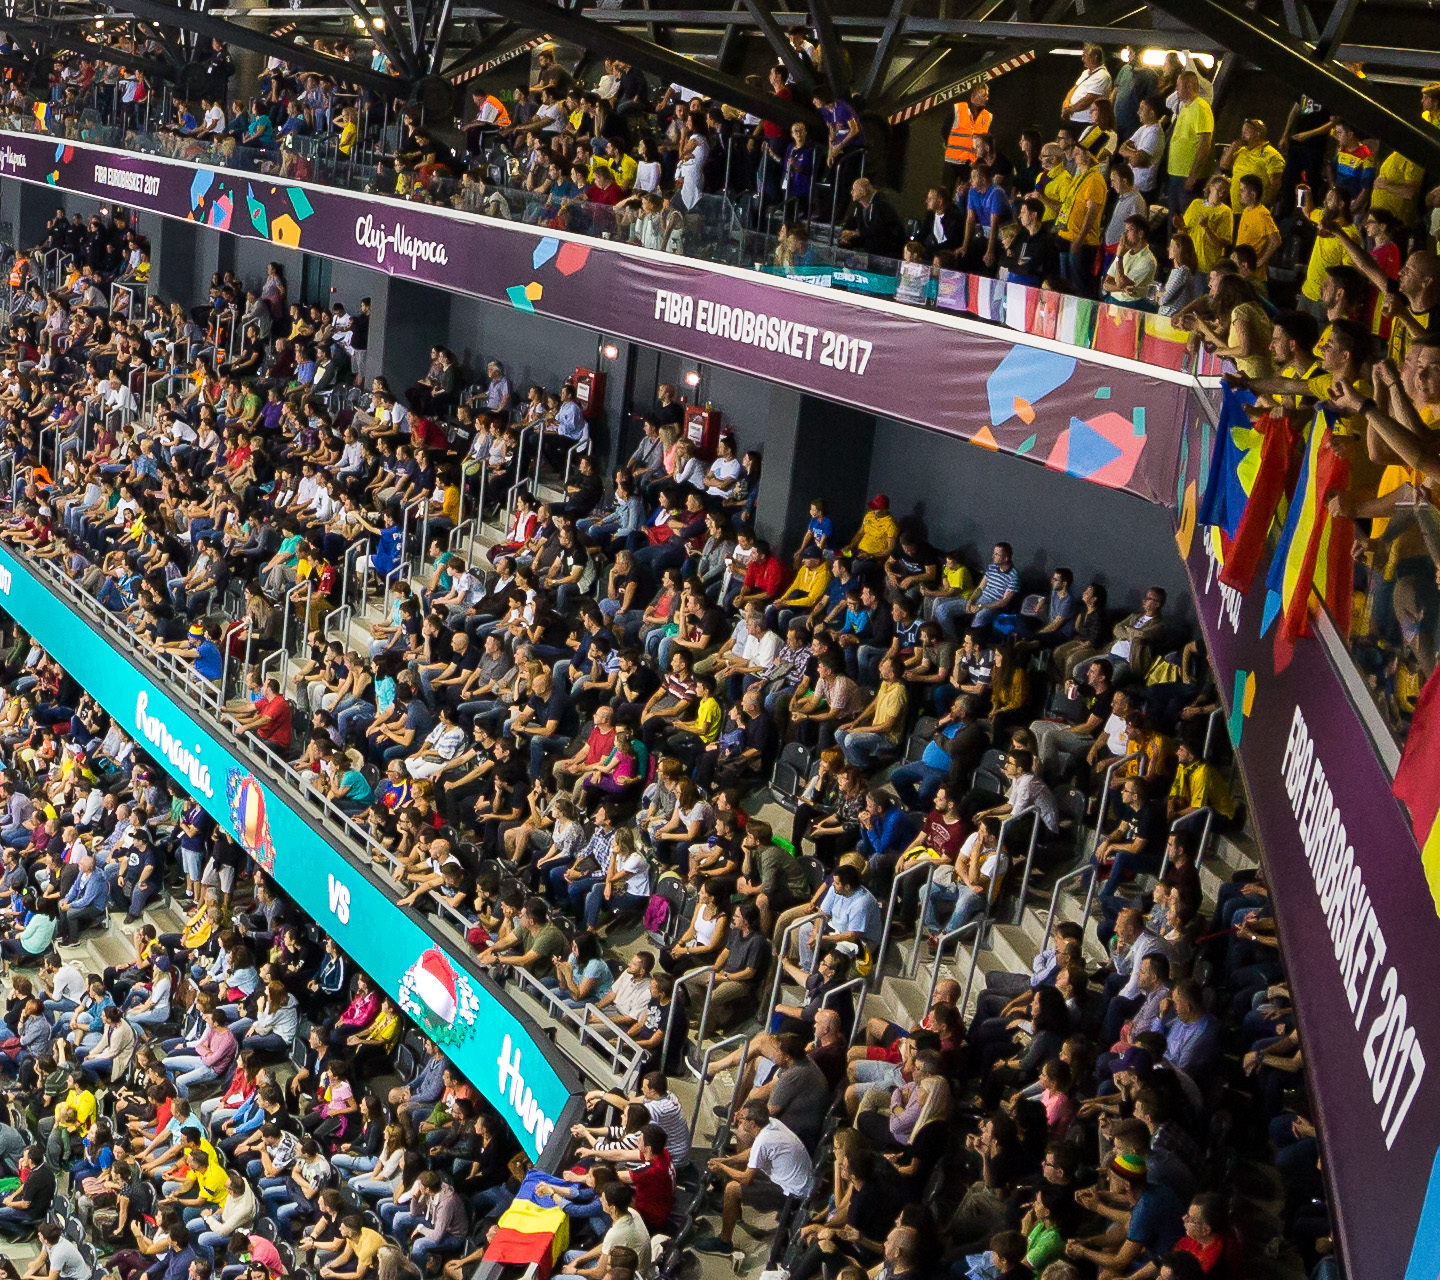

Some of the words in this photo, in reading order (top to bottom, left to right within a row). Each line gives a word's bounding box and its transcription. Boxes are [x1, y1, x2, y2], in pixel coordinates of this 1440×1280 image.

[94, 165, 107, 184] FIBA
[107, 168, 144, 193] EUROBASKET
[144, 174, 160, 197] 2017
[355, 213, 448, 270] Cluj-Napoca
[654, 289, 694, 325] FIBA
[696, 298, 818, 360] EUROBASKET
[820, 331, 872, 376] 2017
[135, 690, 213, 798] Romania
[328, 873, 351, 925] VS
[1281, 704, 1314, 821] FIBA
[1299, 757, 1386, 1031] EUROBASKET
[1363, 966, 1425, 1152] 2017
